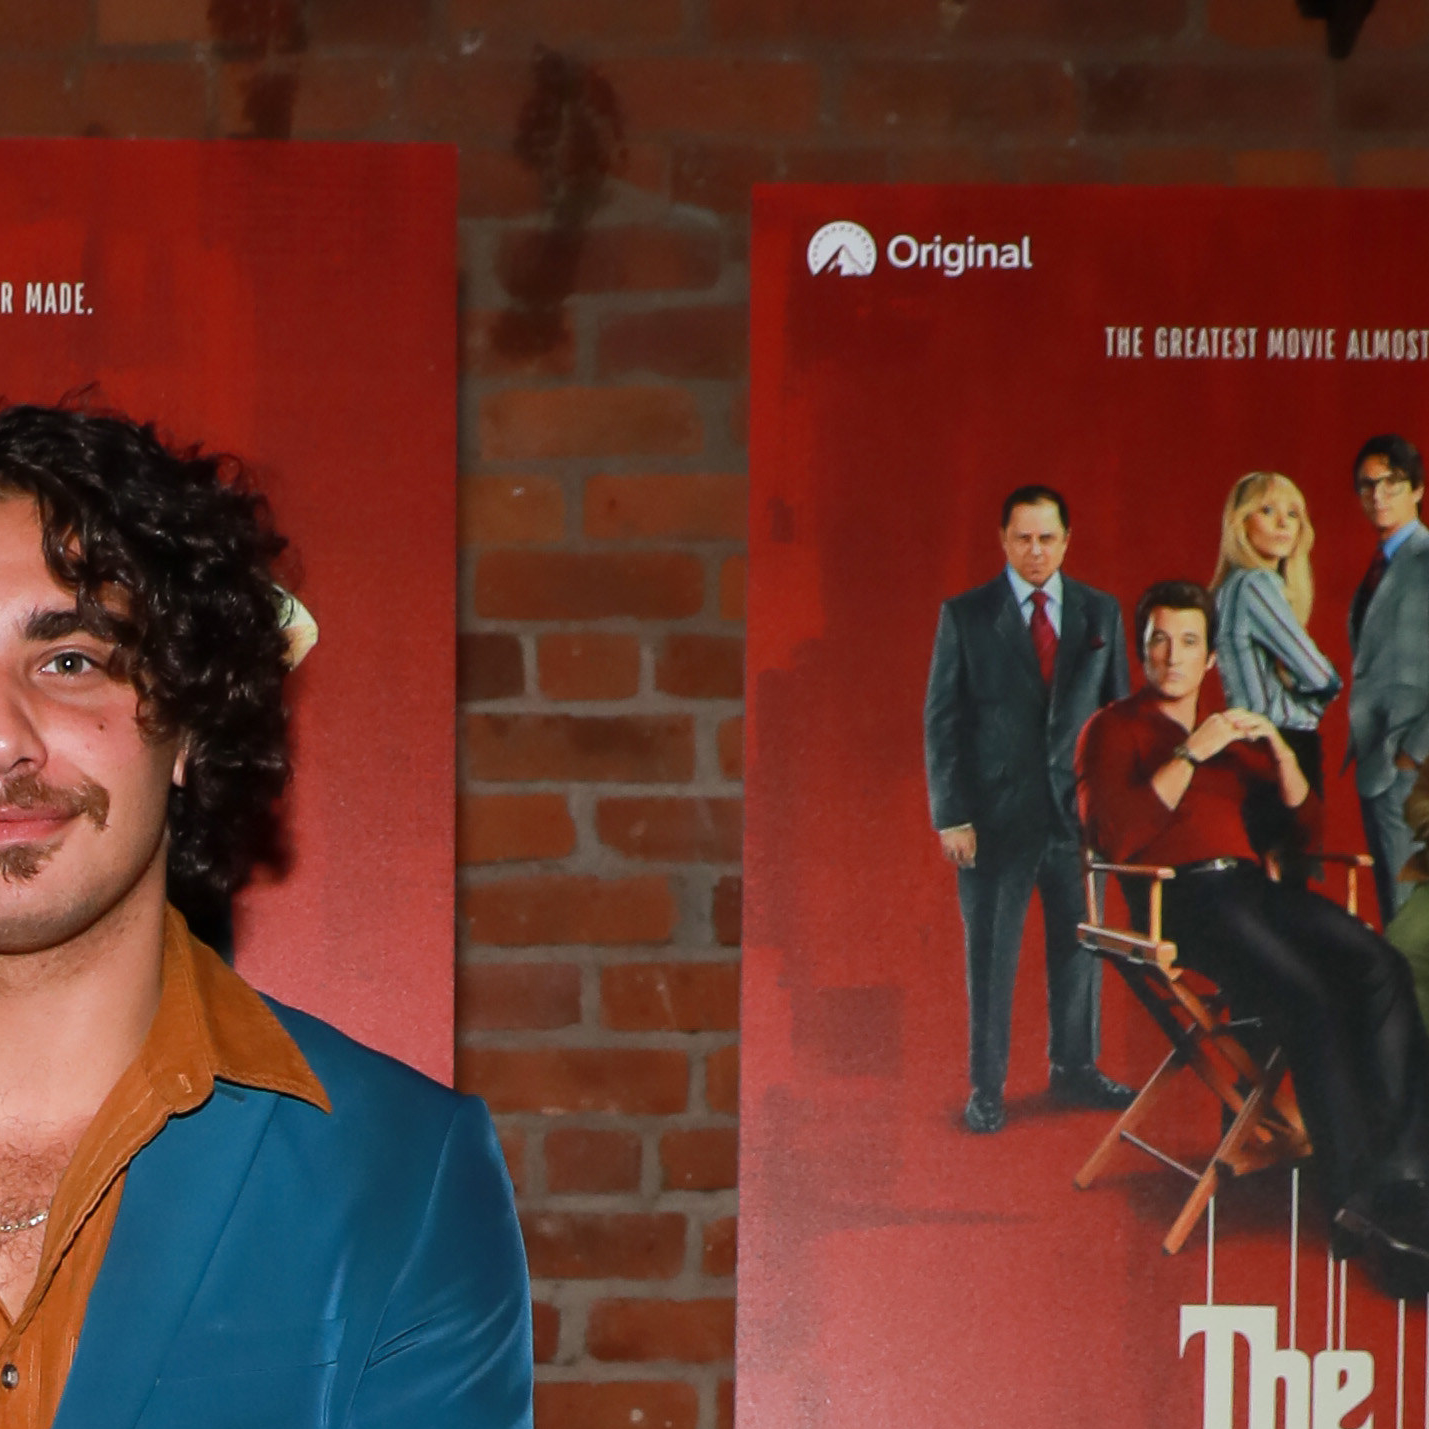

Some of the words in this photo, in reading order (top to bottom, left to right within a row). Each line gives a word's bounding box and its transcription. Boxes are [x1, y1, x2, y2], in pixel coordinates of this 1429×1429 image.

[887, 234, 1034, 278] Original
[26, 283, 94, 316] MADE.
[1105, 326, 1144, 359] THE
[1154, 326, 1259, 360] GREATEST
[1267, 328, 1336, 361] MOVIE
[1346, 328, 1429, 362] ALMOST
